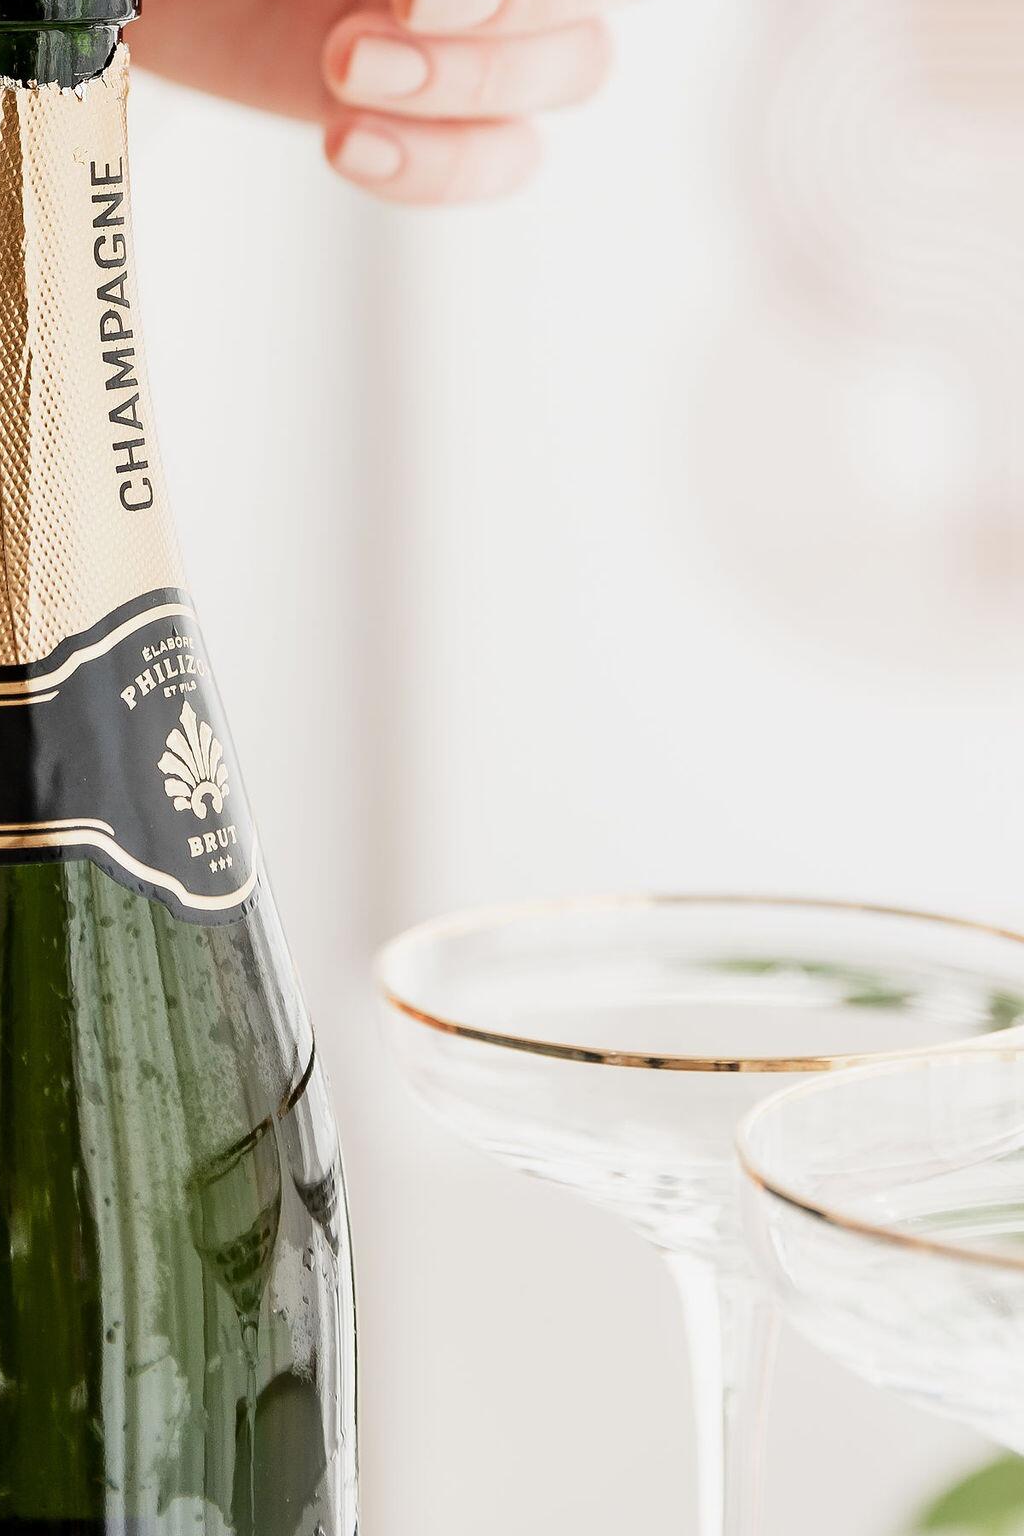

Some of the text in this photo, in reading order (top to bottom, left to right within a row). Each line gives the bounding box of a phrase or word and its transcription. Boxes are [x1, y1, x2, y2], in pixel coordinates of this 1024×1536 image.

[90, 156, 154, 512] CHAMPAGNE
[120, 654, 210, 710] PHILIZO
[163, 684, 177, 698] ET
[187, 825, 237, 857] BRUT
